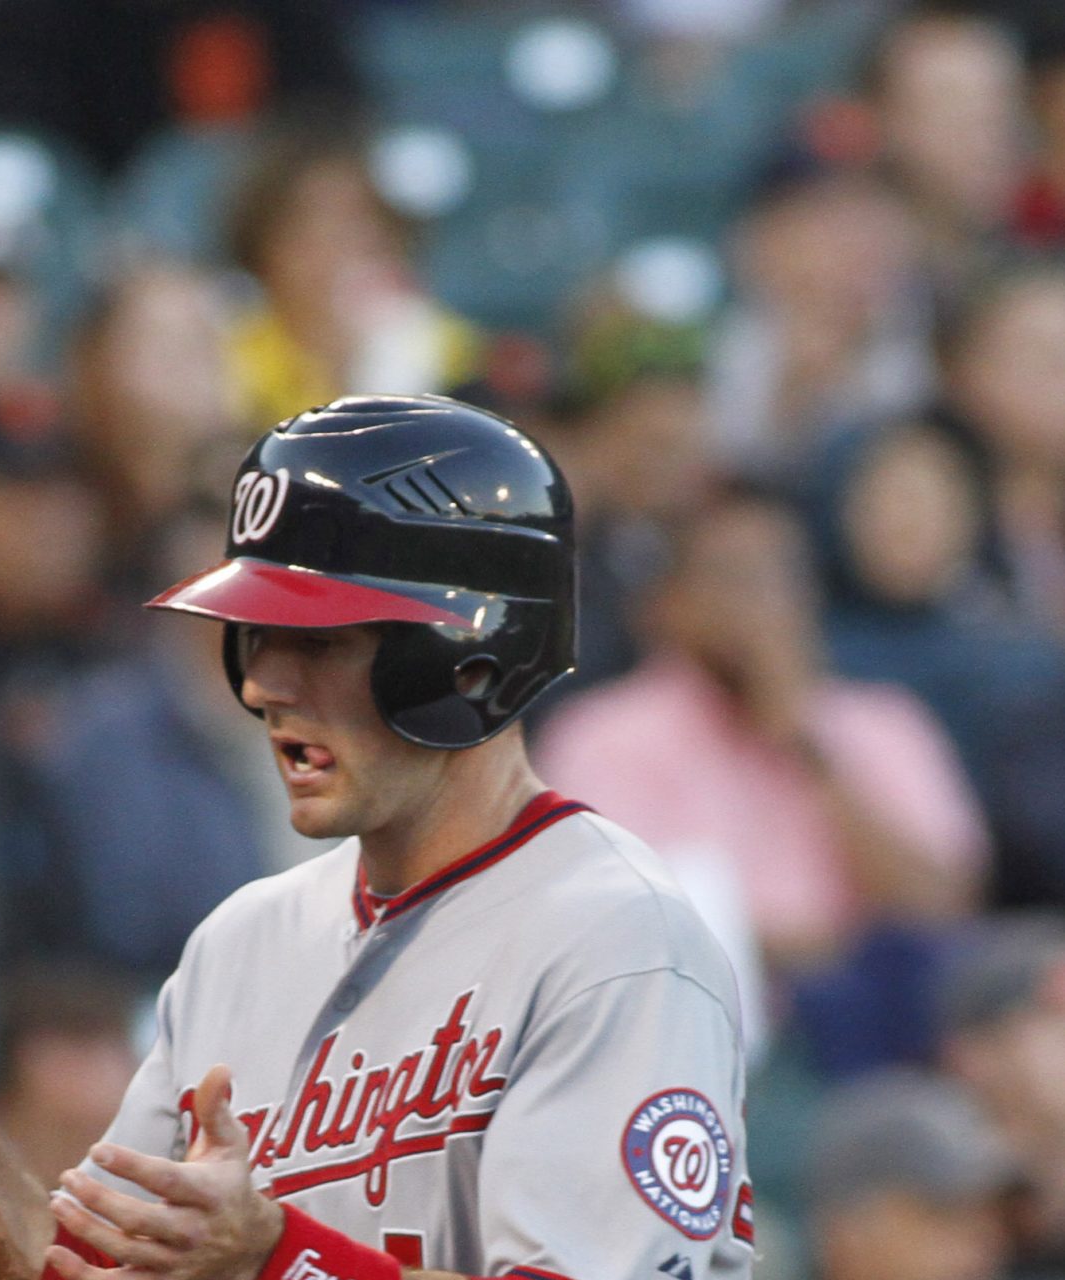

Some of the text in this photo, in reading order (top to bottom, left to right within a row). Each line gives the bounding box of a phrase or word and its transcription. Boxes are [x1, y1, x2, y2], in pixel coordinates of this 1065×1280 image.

[232, 467, 290, 545] W
[633, 1094, 730, 1174] WASHINGTON
[663, 1136, 711, 1192] W
[635, 1170, 721, 1231] NATIONALS
